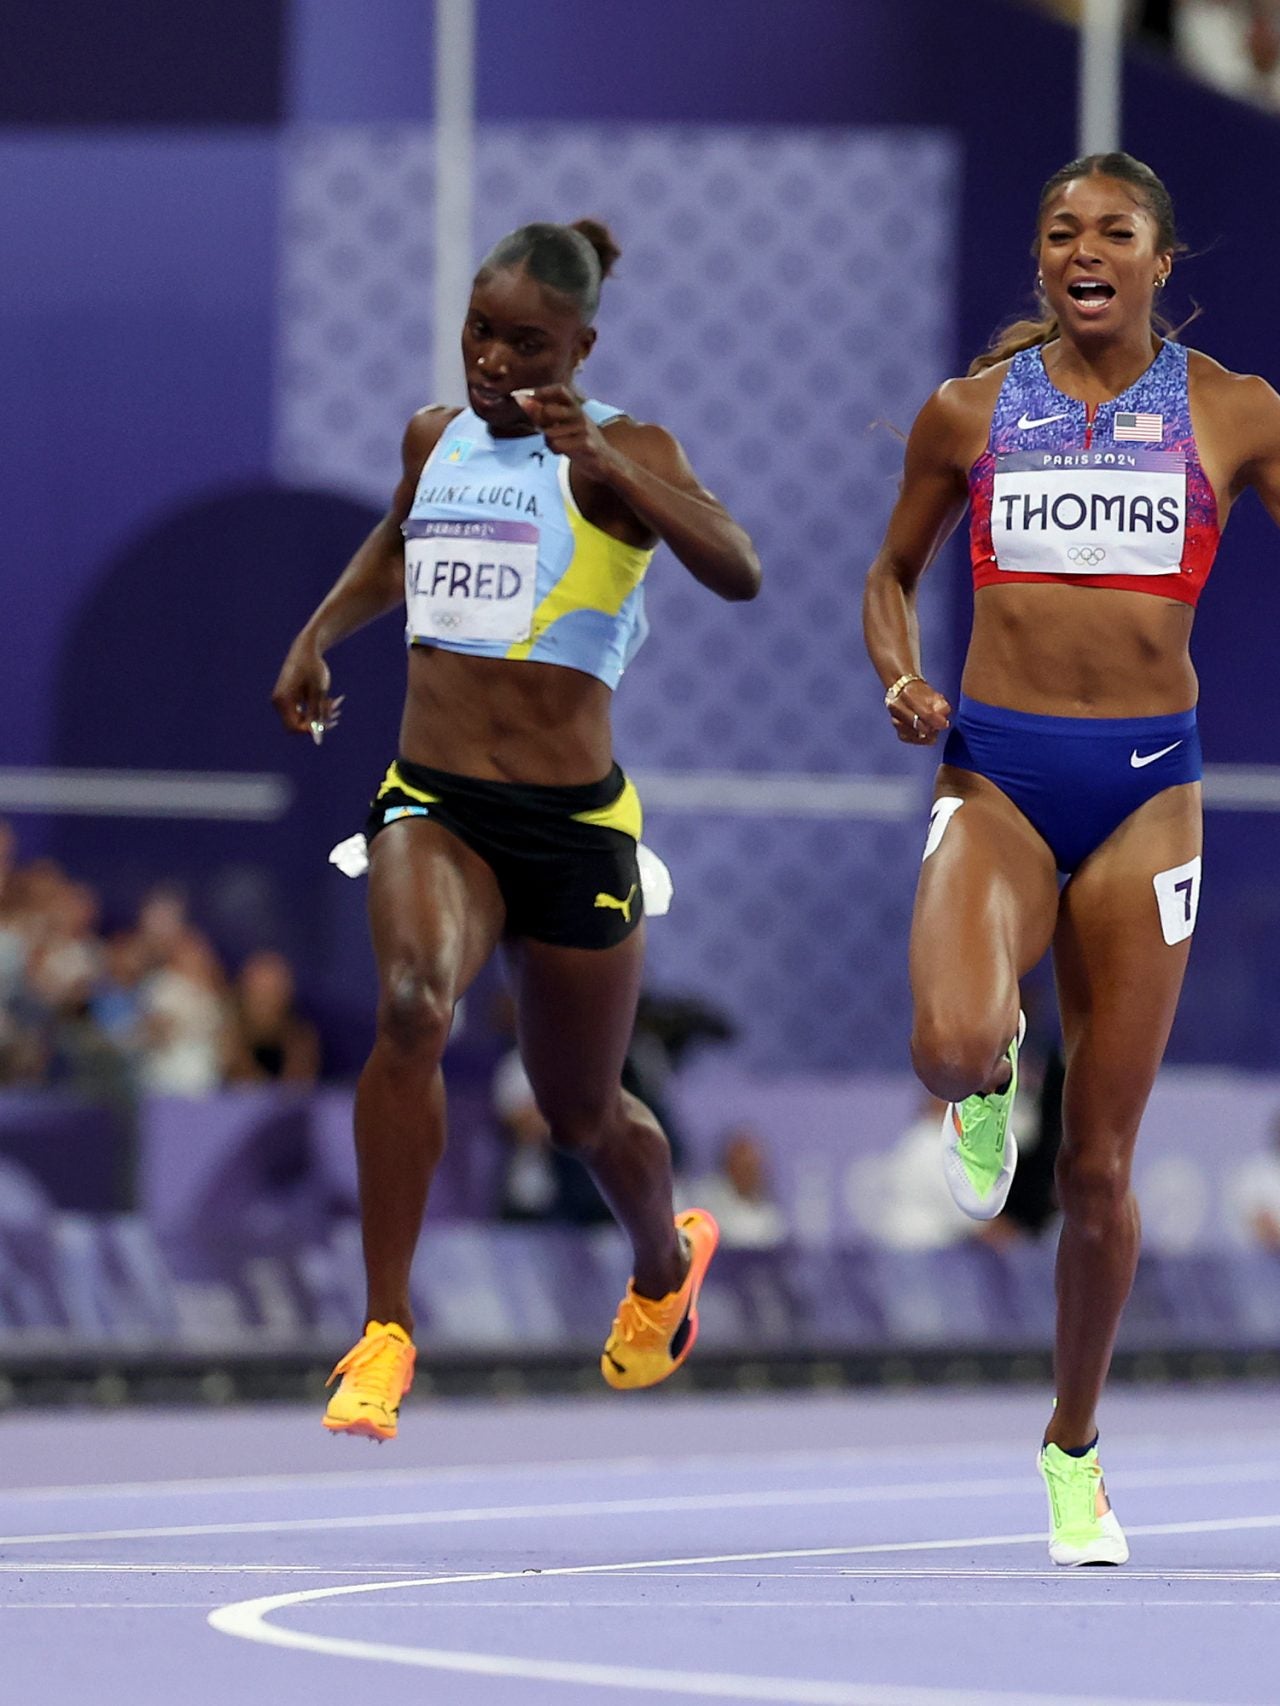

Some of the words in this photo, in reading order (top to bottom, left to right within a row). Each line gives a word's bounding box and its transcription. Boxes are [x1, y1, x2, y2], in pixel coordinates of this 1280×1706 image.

[1043, 454, 1089, 465] PARIS
[1094, 454, 1136, 466] 2024
[477, 486, 537, 517] LUCIA
[1000, 493, 1179, 533] THOMAS
[1175, 877, 1193, 922] 7
